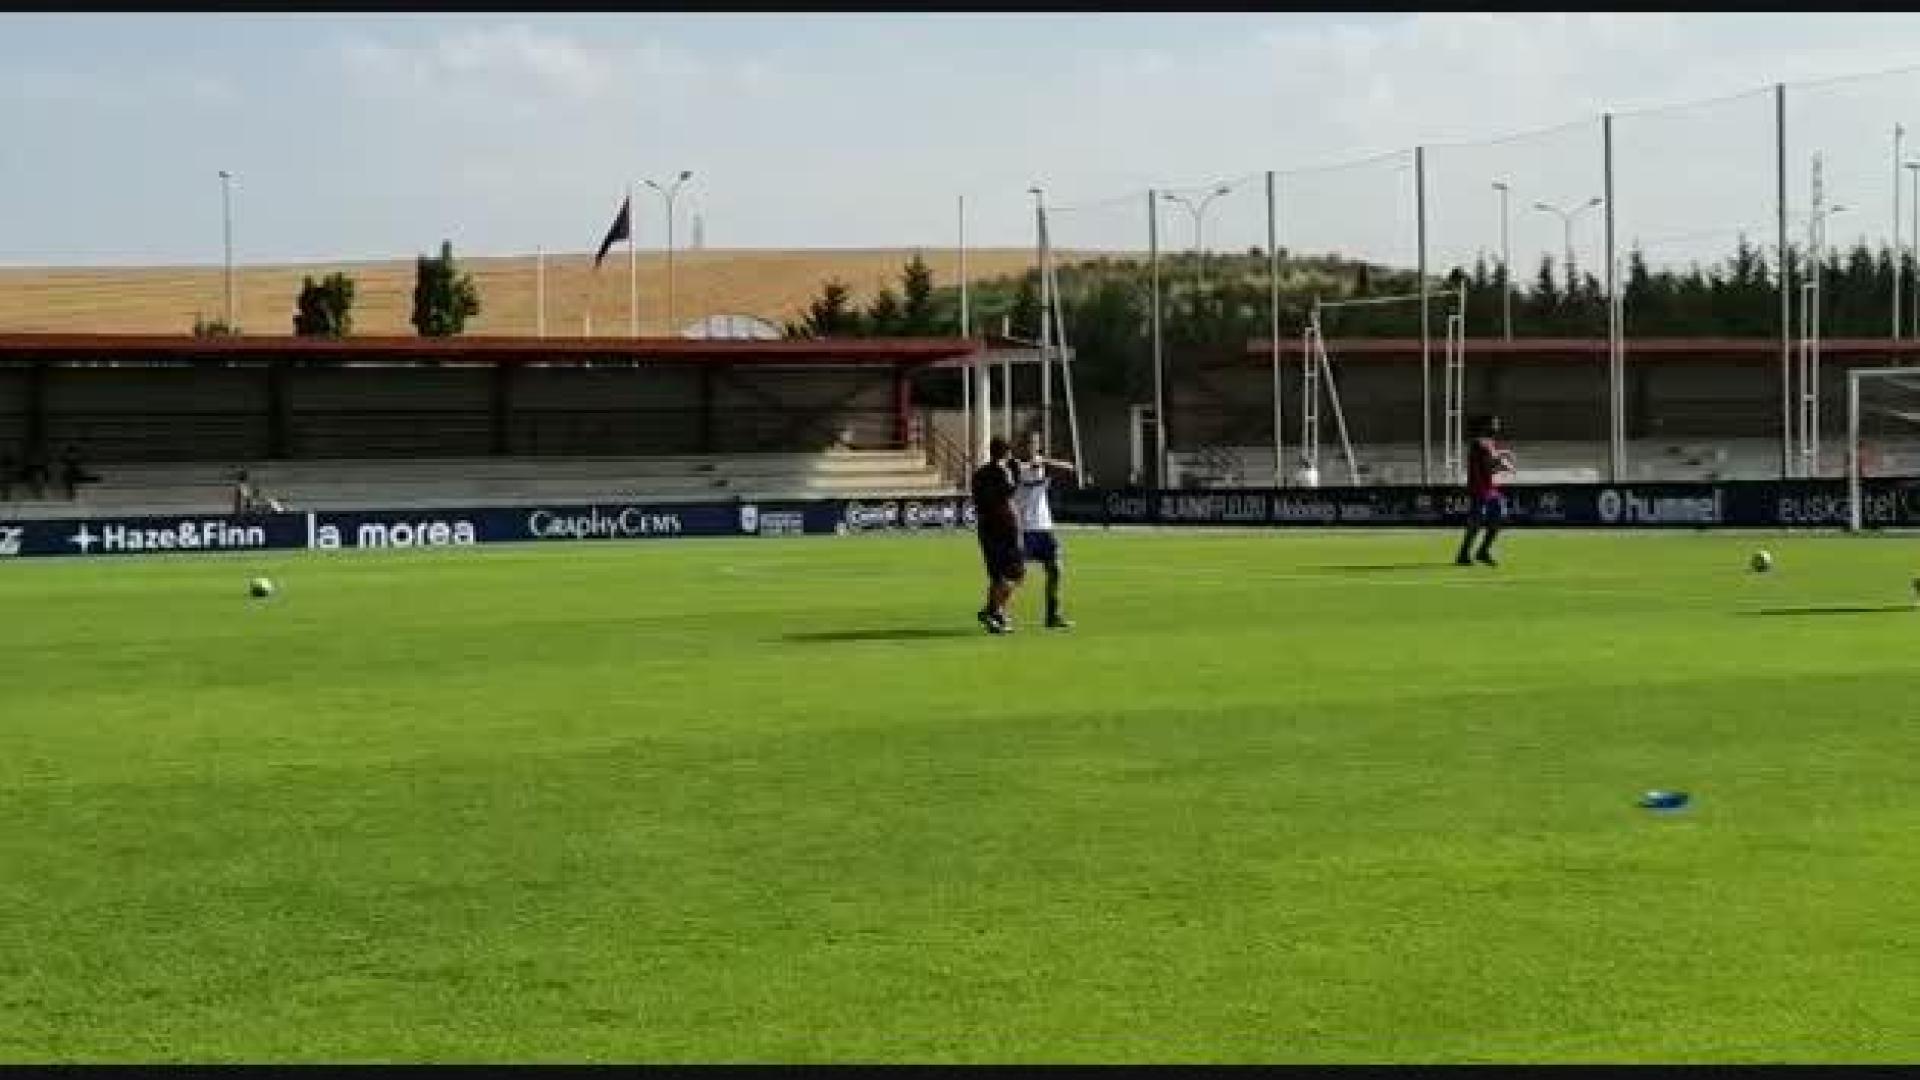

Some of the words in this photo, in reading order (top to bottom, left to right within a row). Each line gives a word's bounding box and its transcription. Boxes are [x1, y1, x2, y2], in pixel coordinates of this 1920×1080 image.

[102, 520, 267, 549] Haze&Finn
[307, 512, 341, 549] la
[359, 518, 476, 547] morea
